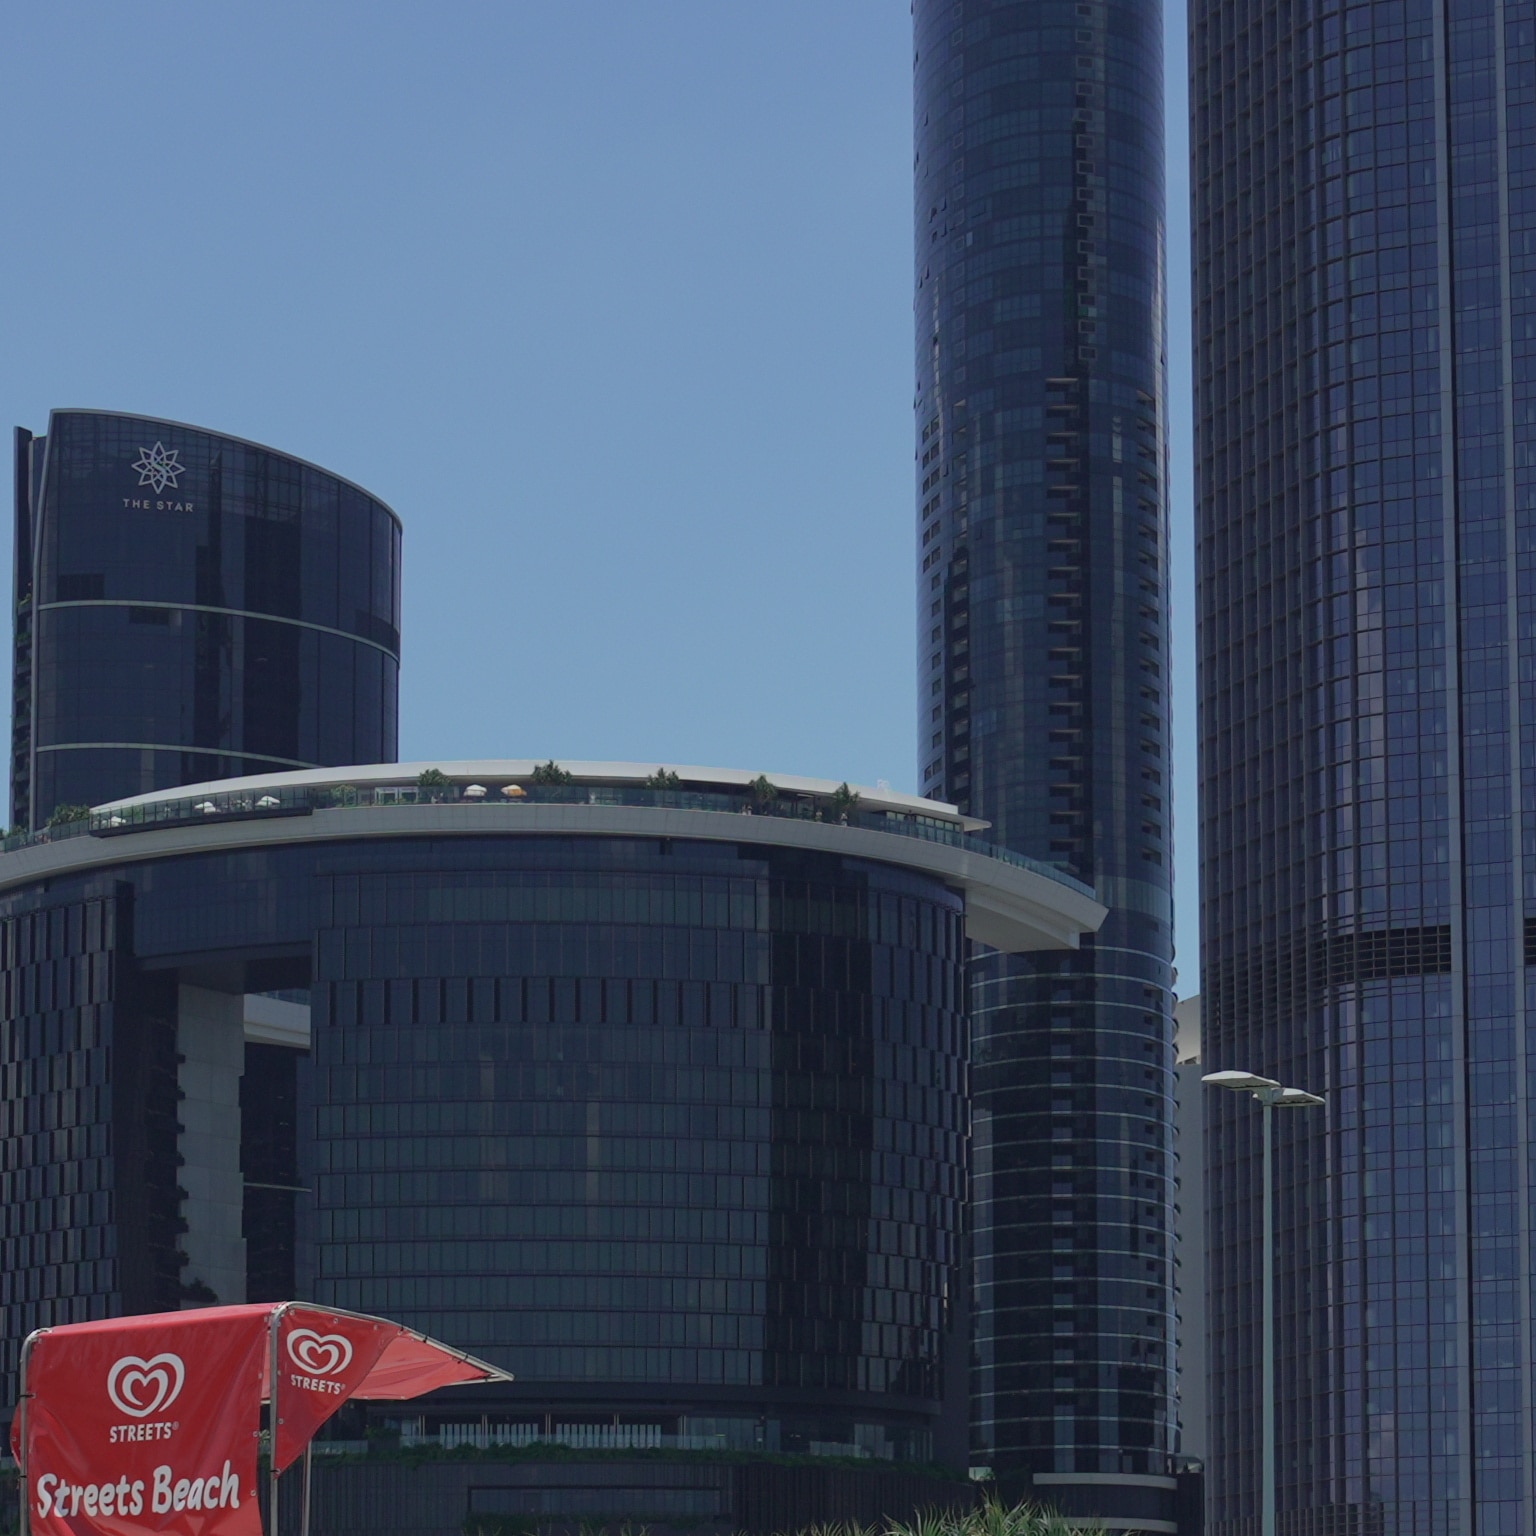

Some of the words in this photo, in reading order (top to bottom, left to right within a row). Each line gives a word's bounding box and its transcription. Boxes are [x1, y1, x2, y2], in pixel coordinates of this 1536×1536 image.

[123, 498, 150, 510] THE
[156, 500, 194, 512] STAR
[36, 1472, 144, 1518] Streets
[151, 1459, 240, 1513] Beach
